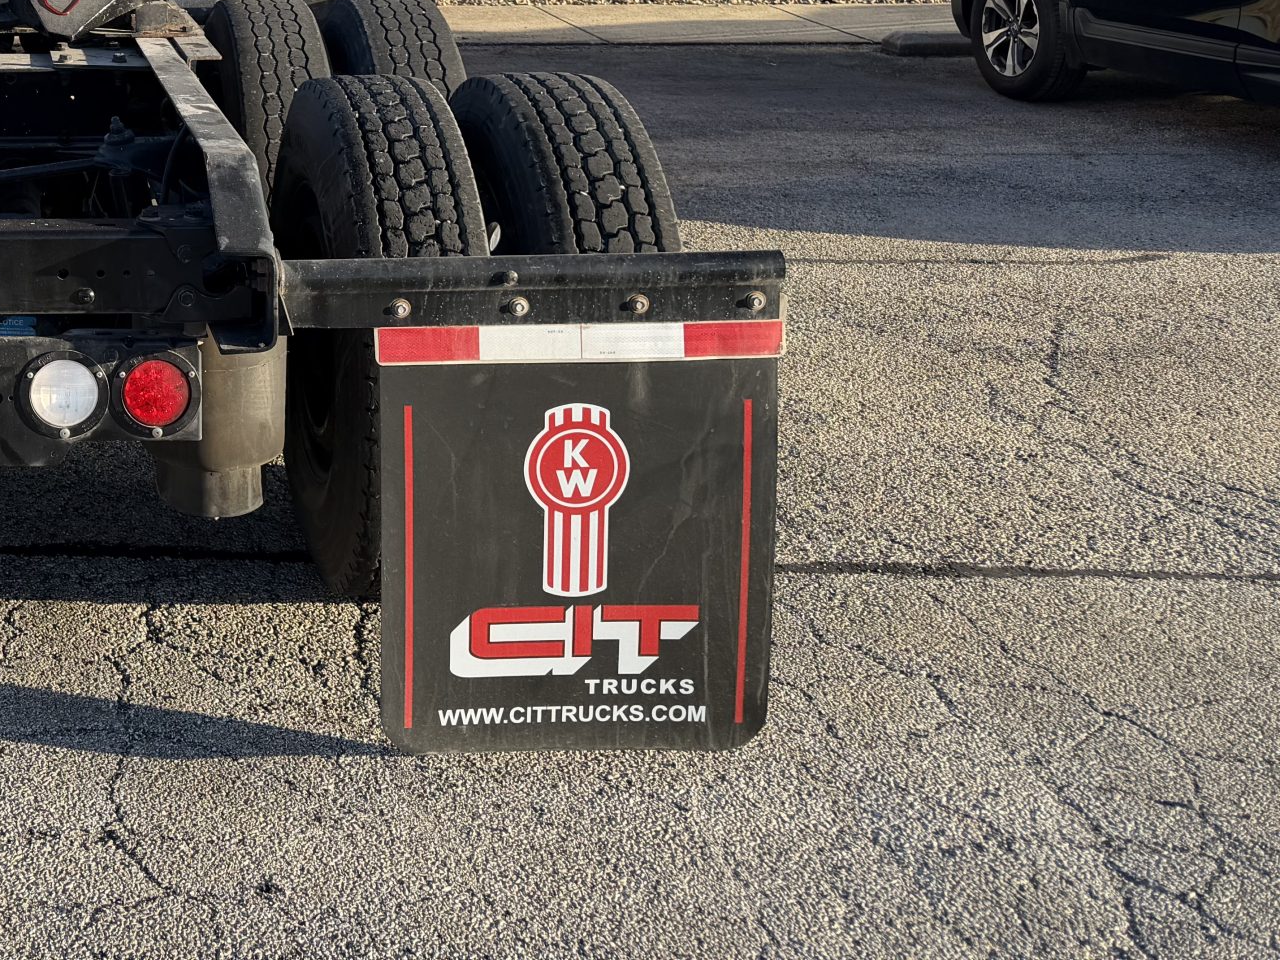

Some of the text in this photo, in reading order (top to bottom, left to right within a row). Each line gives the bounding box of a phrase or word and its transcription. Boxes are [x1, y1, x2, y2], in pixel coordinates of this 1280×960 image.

[449, 604, 700, 678] CIT
[584, 678, 695, 695] TRUCKS
[438, 704, 707, 726] WWW.CITTRUCKS.COM
